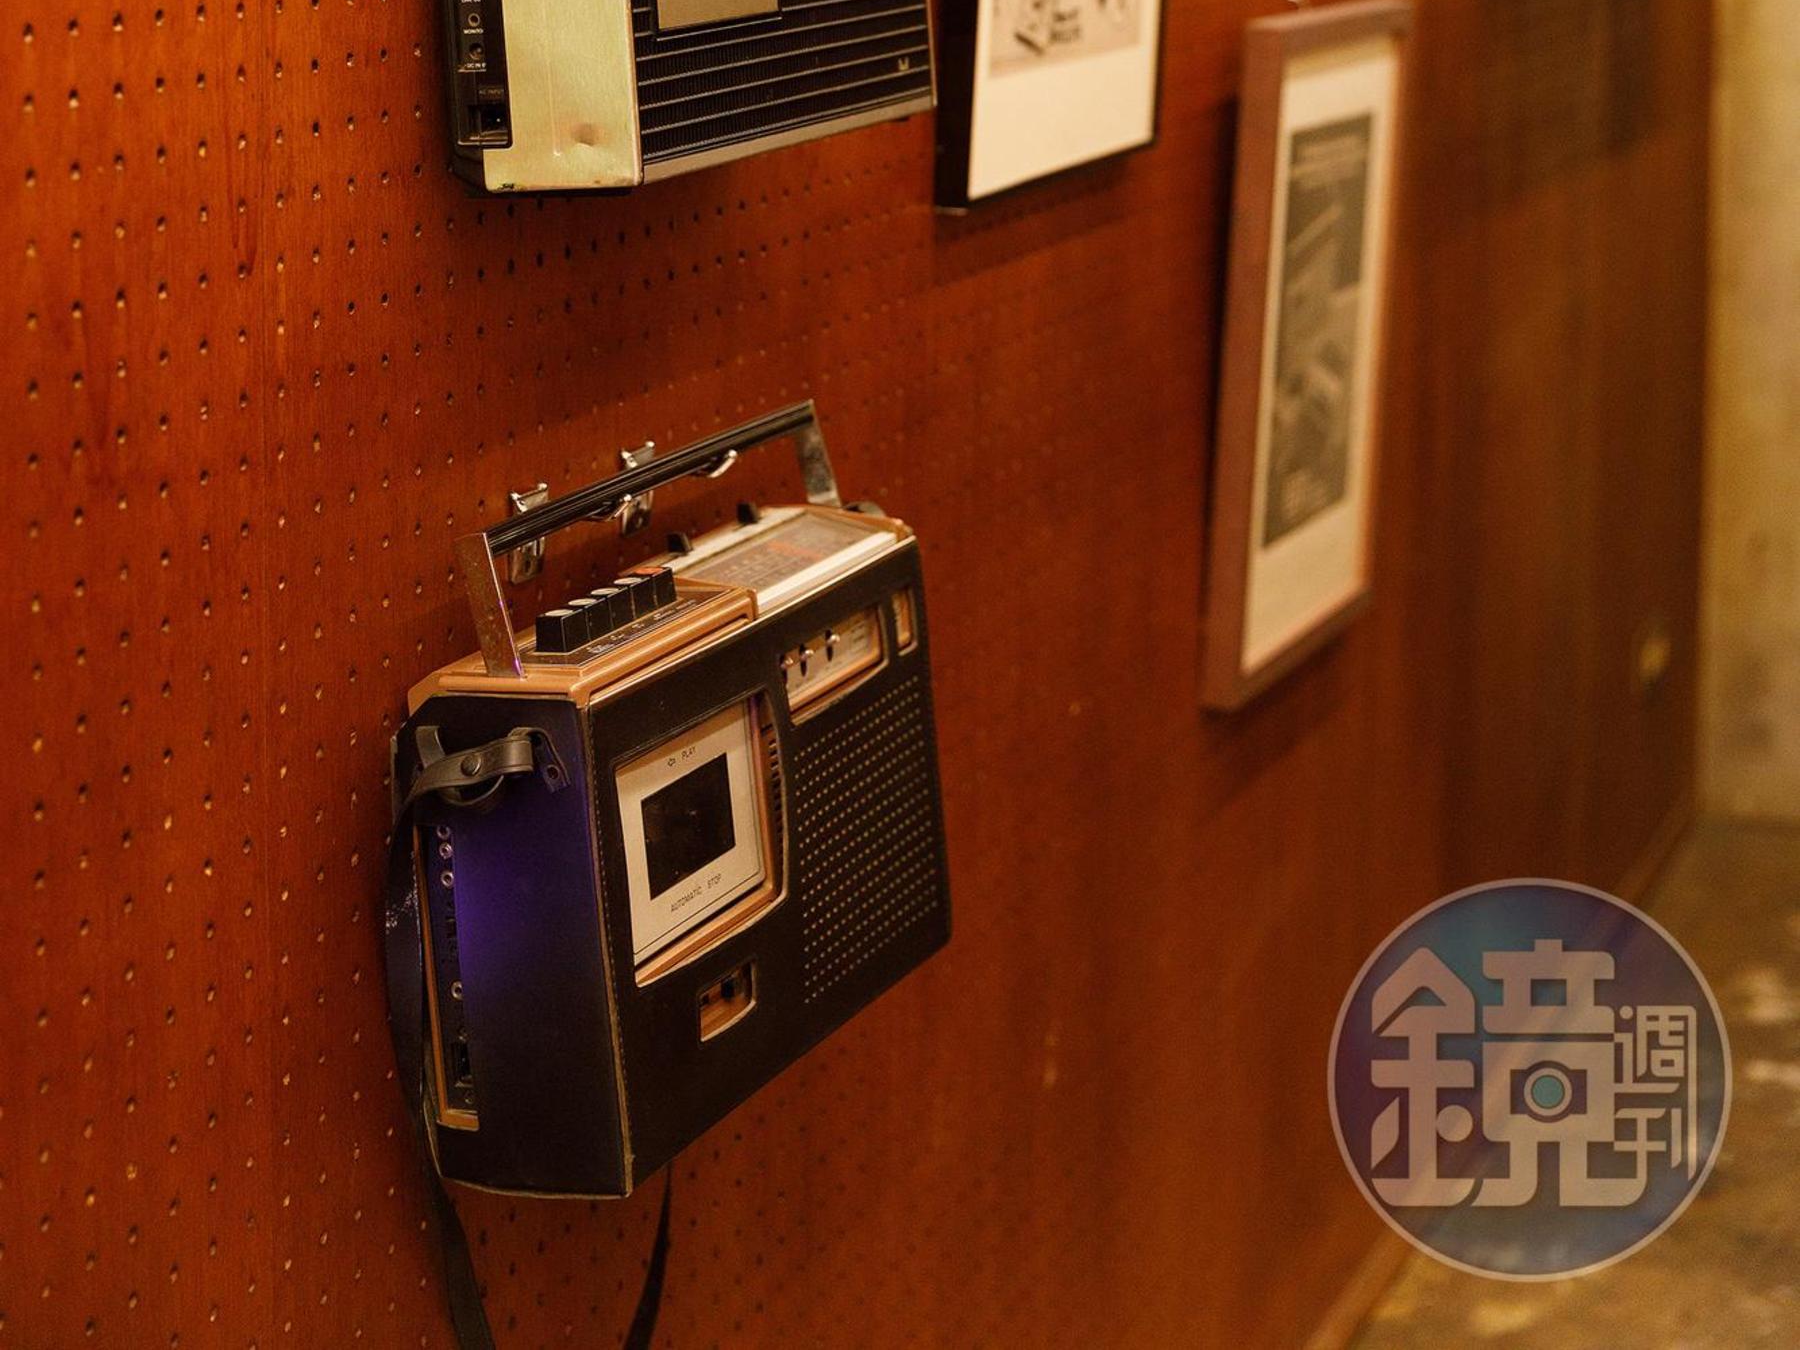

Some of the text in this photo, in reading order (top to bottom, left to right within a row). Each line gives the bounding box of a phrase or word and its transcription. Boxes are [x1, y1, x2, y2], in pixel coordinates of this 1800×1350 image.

[681, 746, 696, 760] PLAY
[671, 873, 721, 912] AUTOMATIC STOP
